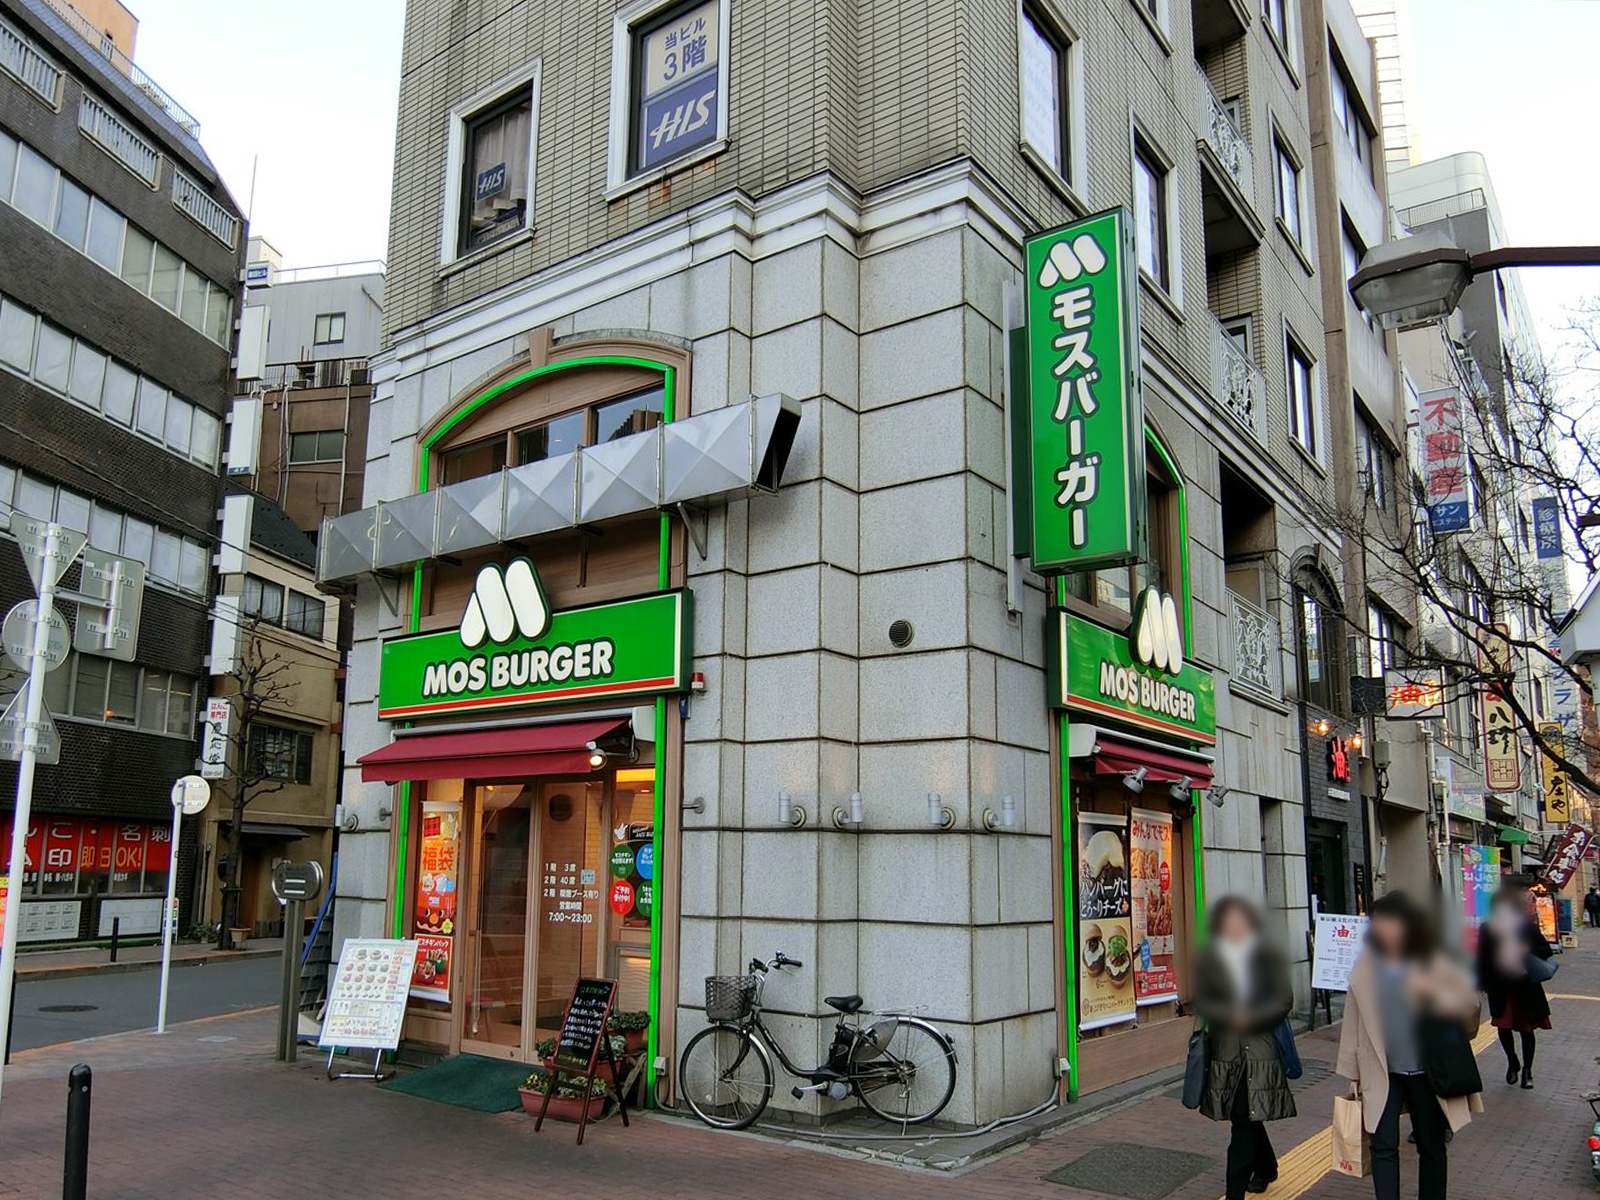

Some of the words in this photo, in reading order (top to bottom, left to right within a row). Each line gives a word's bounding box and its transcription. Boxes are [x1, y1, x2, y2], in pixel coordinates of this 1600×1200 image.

[663, 35, 707, 80] 3階
[665, 17, 706, 50] 当ビル
[1053, 287, 1098, 546] モスバーガー
[422, 657, 487, 696] MOS
[491, 641, 614, 688] BURGER
[1100, 662, 1139, 705] MOS
[1141, 676, 1196, 722] BURGER
[423, 846, 454, 871] 福袋
